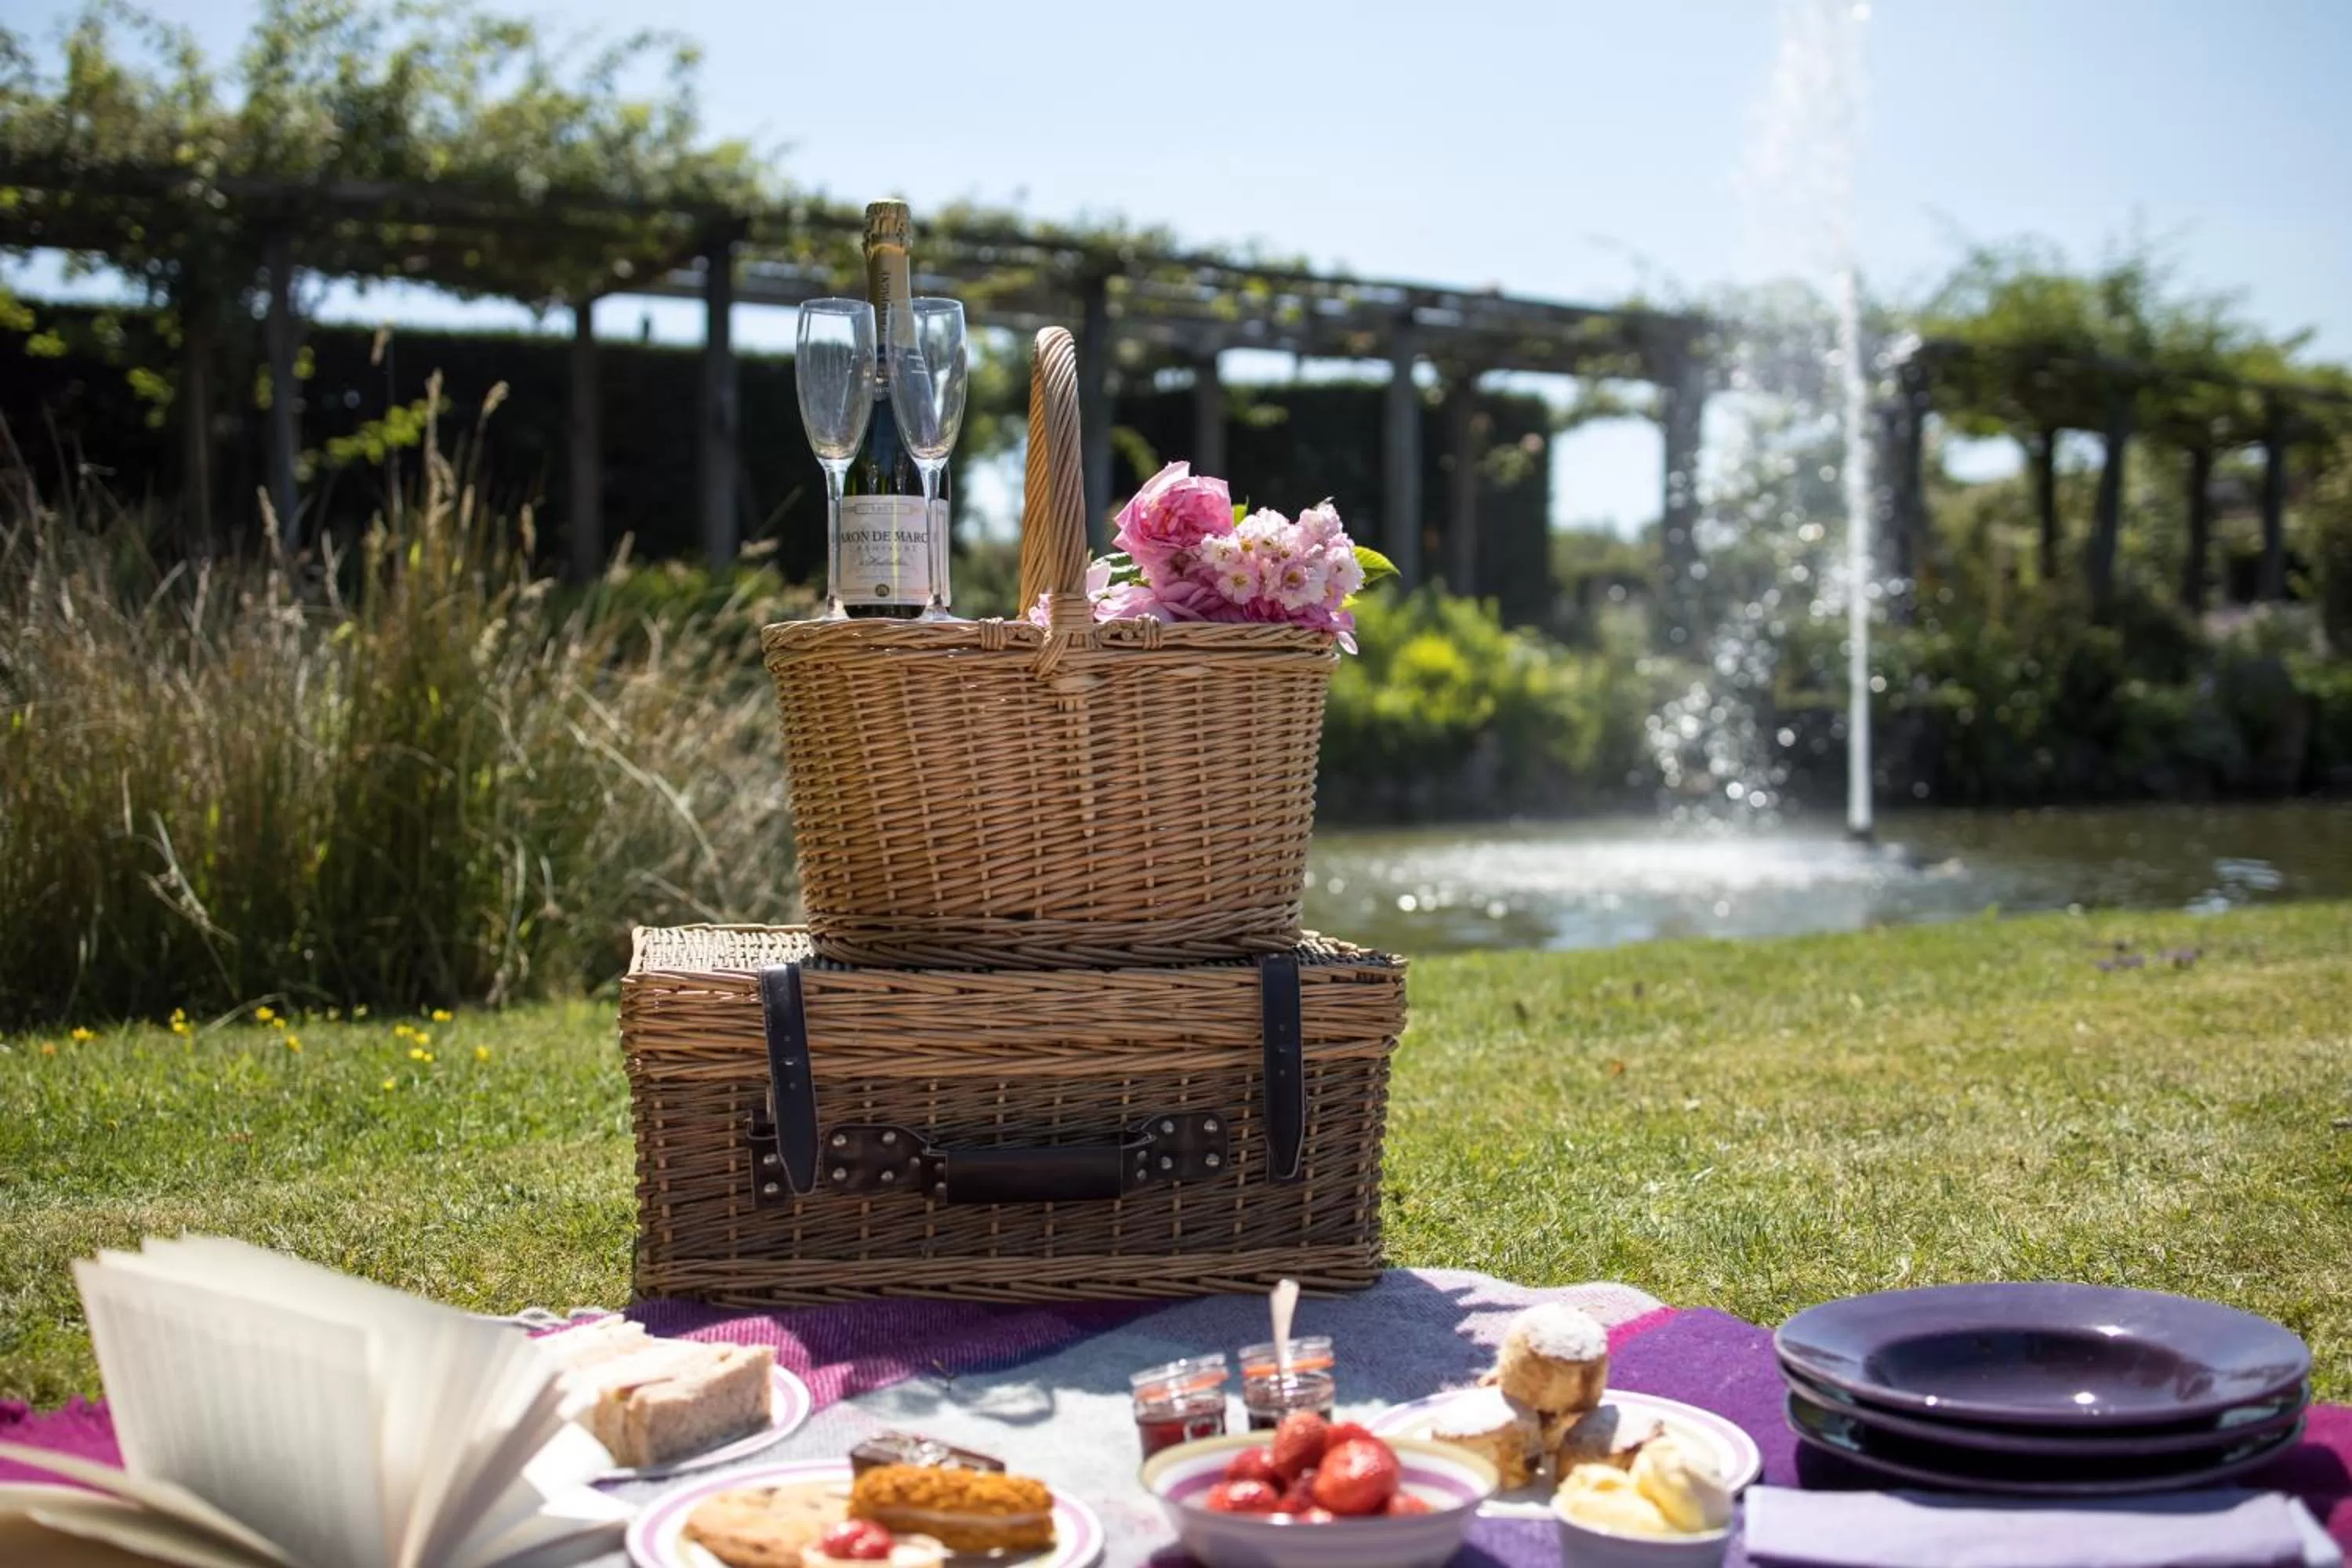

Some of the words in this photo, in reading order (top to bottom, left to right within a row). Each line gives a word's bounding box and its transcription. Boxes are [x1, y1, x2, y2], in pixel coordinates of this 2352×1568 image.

[840, 530, 870, 543] ARON
[873, 531, 891, 542] DE
[895, 530, 928, 543] MARC
